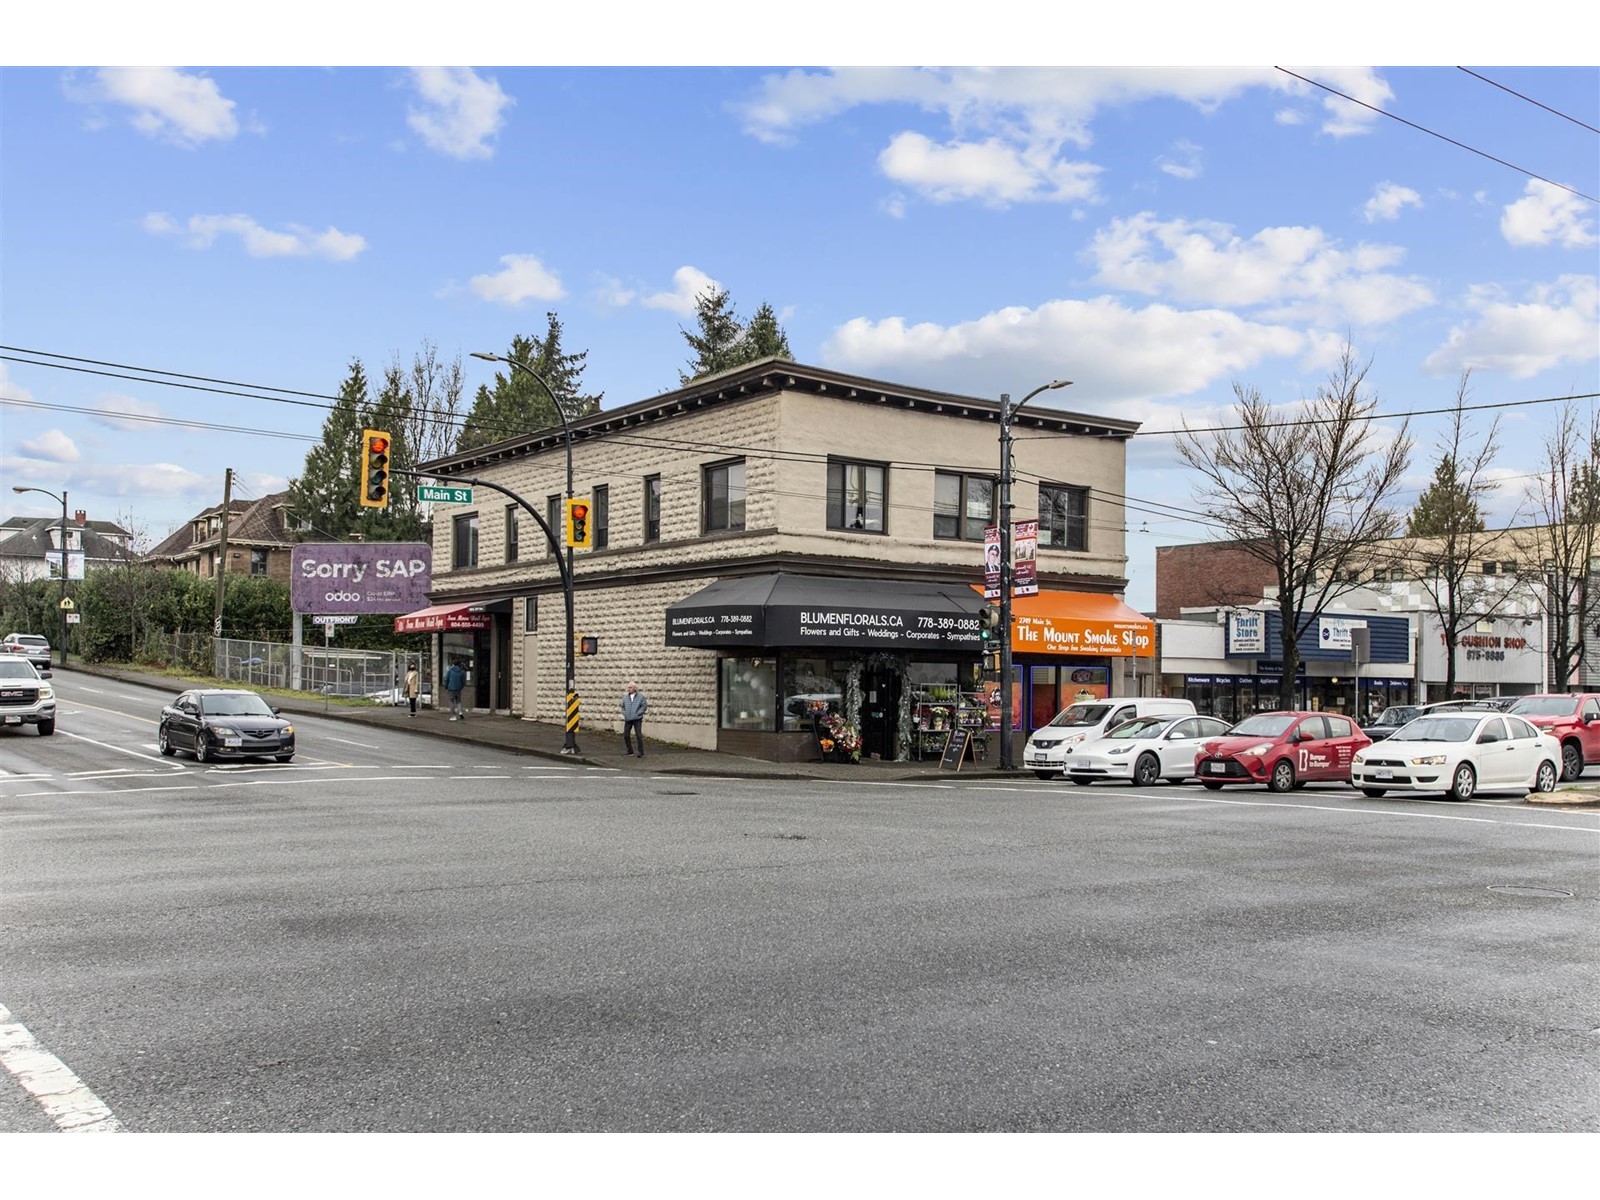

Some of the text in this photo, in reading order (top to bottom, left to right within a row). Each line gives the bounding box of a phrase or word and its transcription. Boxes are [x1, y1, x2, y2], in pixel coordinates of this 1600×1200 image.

[424, 489, 467, 501] Main St
[302, 559, 426, 583] Sorry SAP
[325, 590, 360, 602] odoo
[672, 617, 715, 626] BLUMENFLORALS.CA
[800, 612, 980, 630] BLUMENFLORALS.CA 778-389-0882
[1236, 618, 1258, 627] Thrift
[800, 627, 826, 636] Flowers
[829, 628, 841, 636] and
[844, 628, 859, 637] Gifts
[868, 629, 898, 639] Weddings
[906, 630, 939, 640] Corporates
[947, 632, 980, 642] Sympathies
[1236, 628, 1258, 638] Store
[1333, 628, 1348, 638] Thrift
[1462, 635, 1501, 648] CUSHION
[1504, 637, 1526, 649] SHOP
